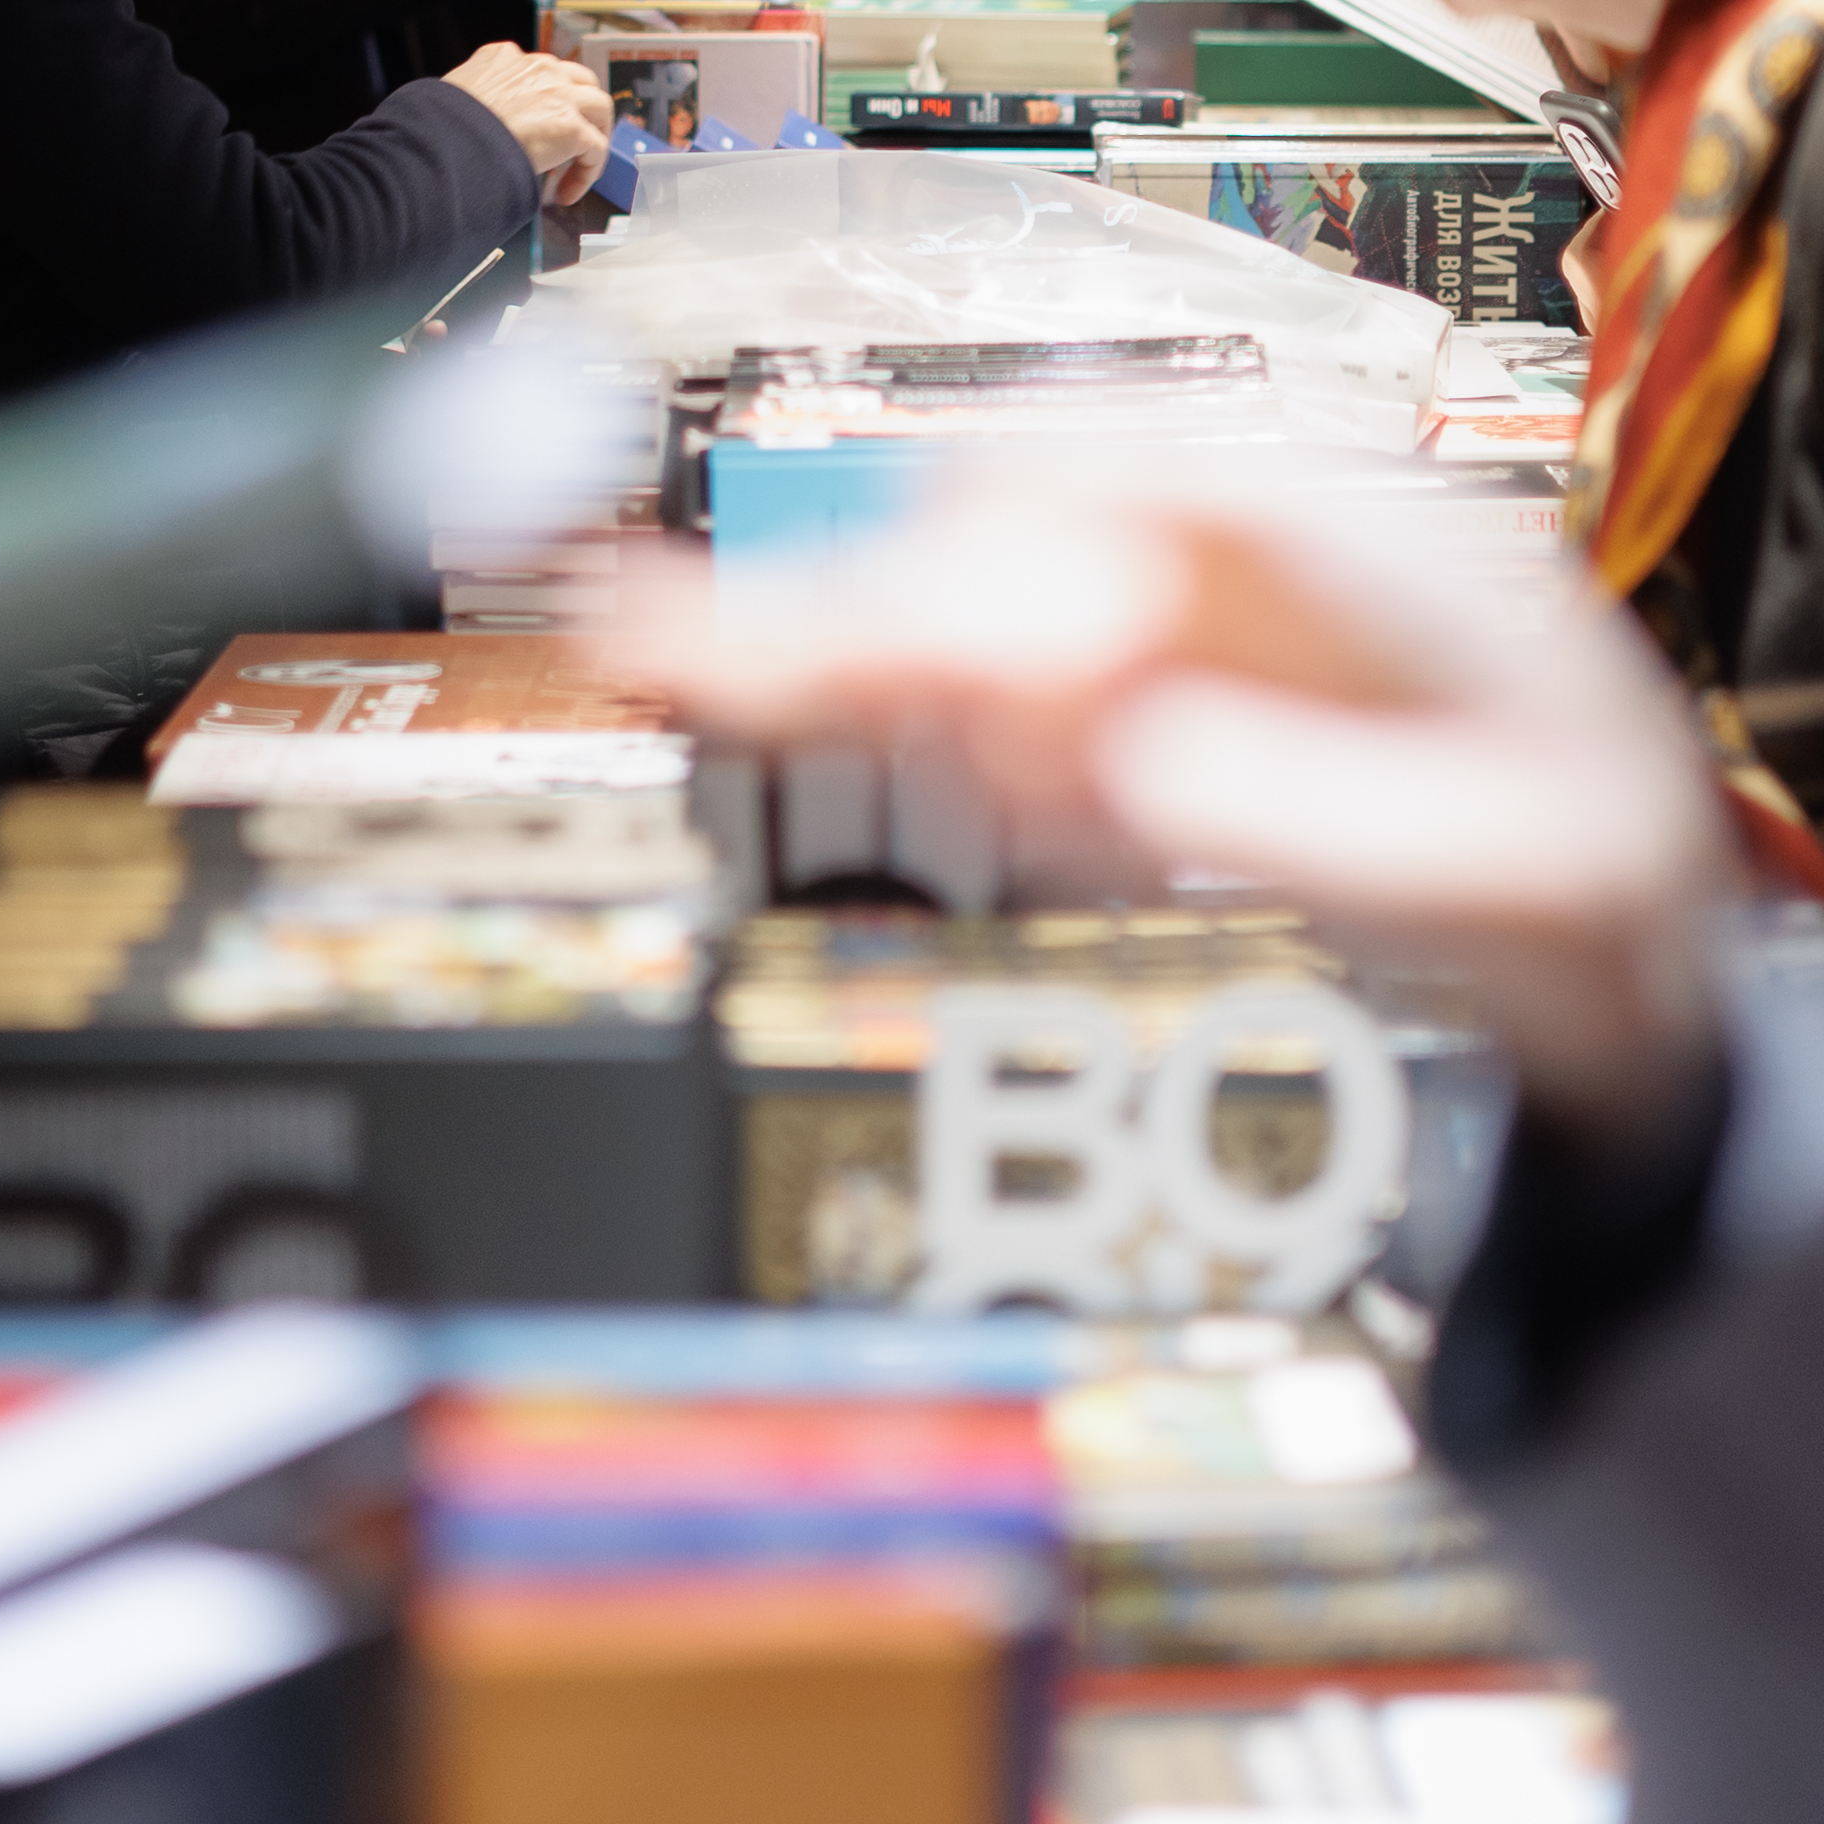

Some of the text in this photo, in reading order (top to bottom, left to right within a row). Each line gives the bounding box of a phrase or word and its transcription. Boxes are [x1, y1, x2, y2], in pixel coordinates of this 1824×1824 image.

[866, 97, 903, 119] Они
[904, 98, 919, 115] и
[921, 98, 952, 118] Мы
